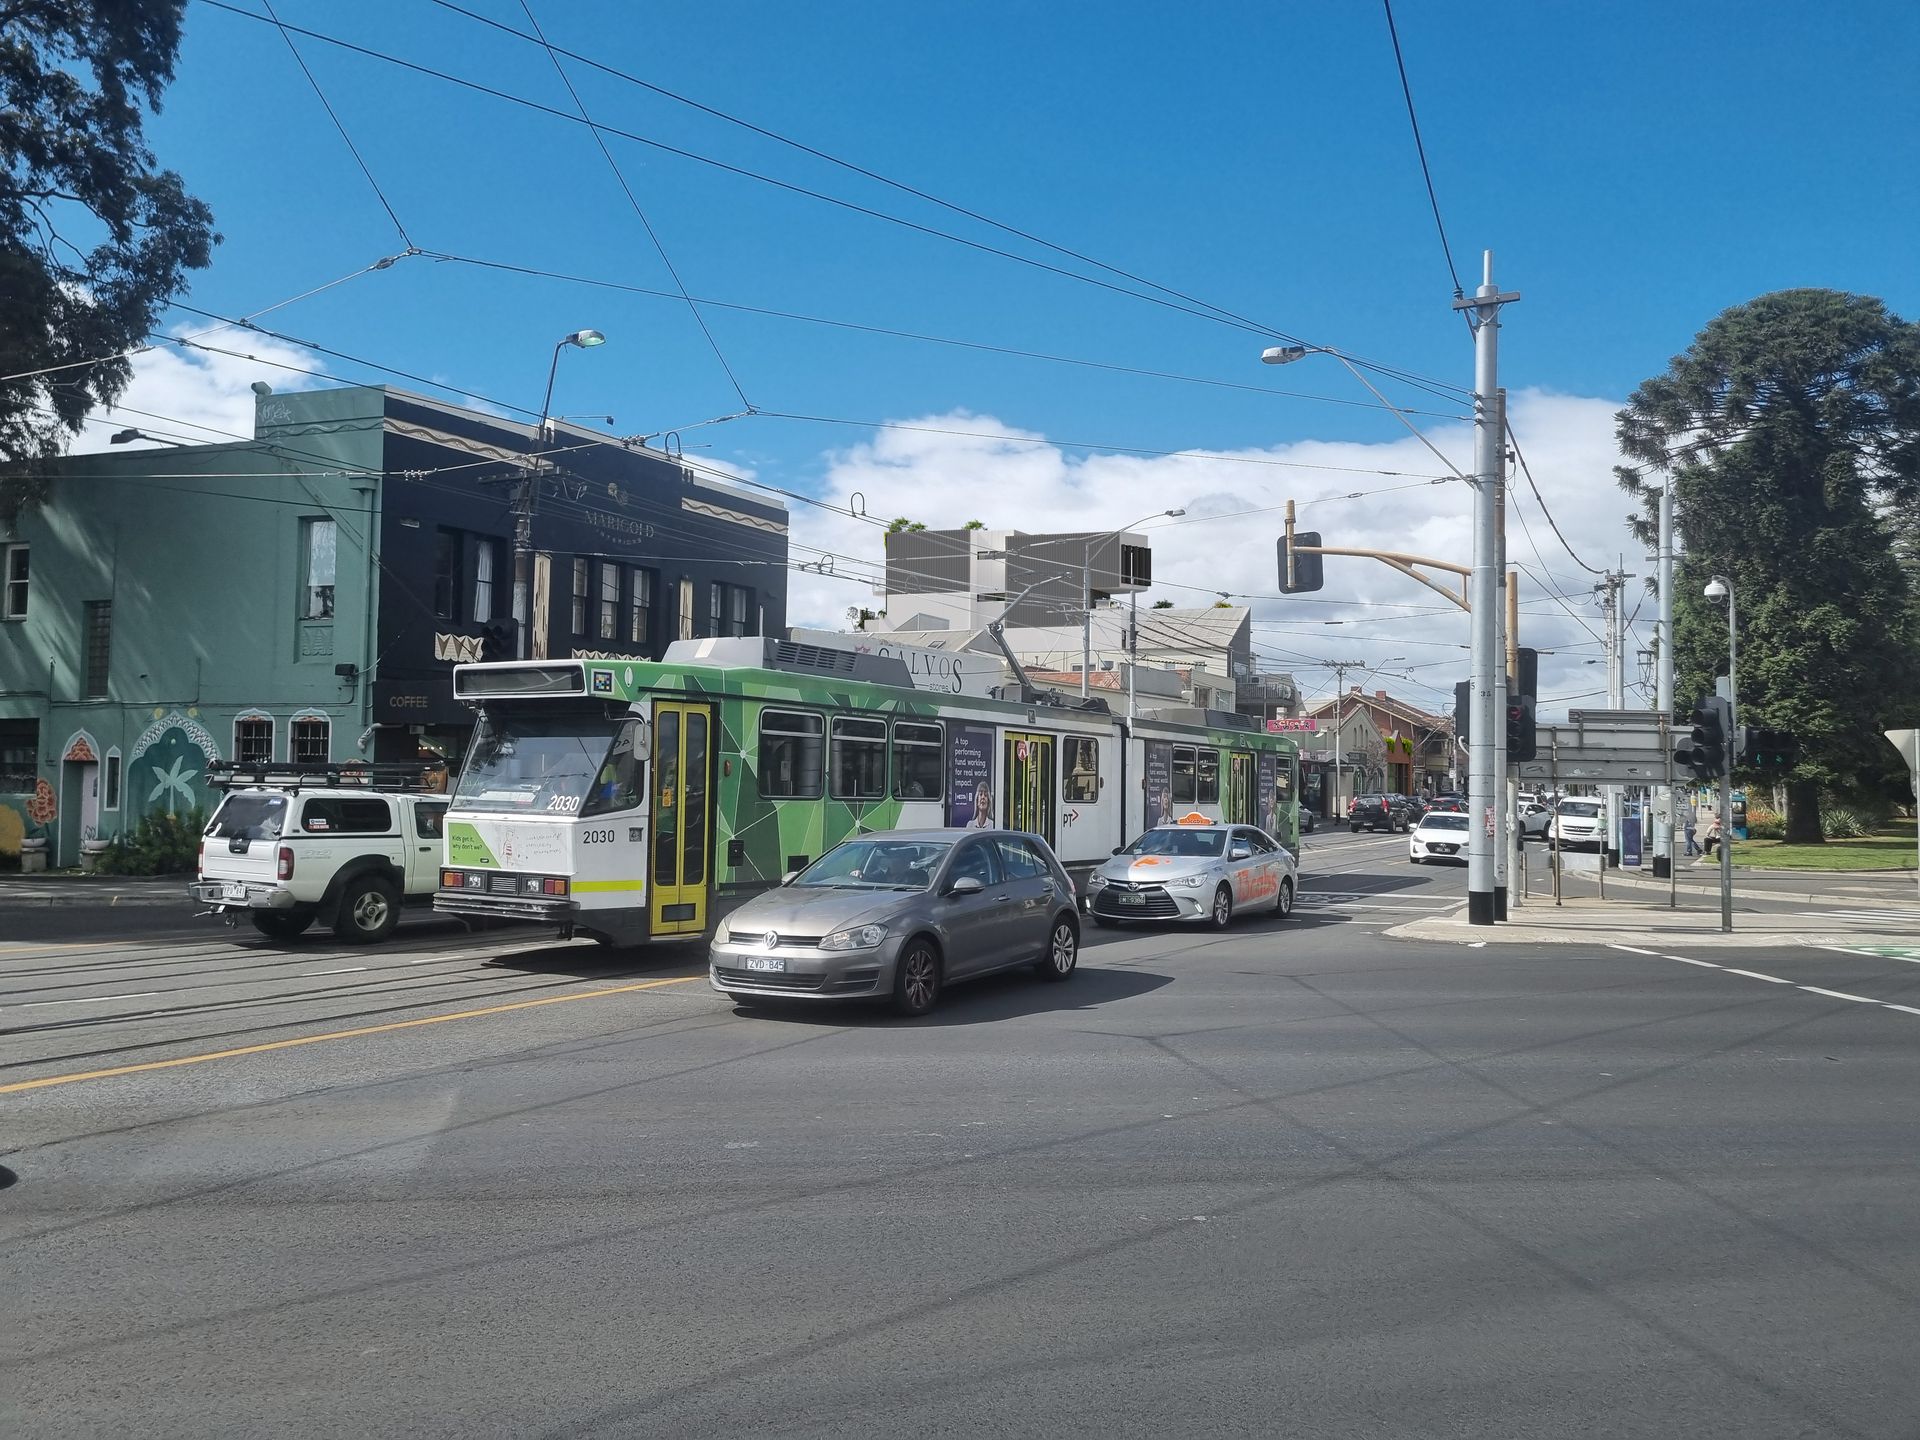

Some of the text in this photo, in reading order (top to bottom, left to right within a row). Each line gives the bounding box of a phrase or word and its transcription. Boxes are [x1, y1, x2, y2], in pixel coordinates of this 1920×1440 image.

[585, 510, 655, 537] MARIGOLD
[389, 696, 428, 708] COFFEE
[960, 738, 968, 746] top
[955, 748, 981, 758] performing
[955, 758, 986, 768] fund working
[547, 795, 580, 811] 2030
[583, 829, 615, 844] 2030
